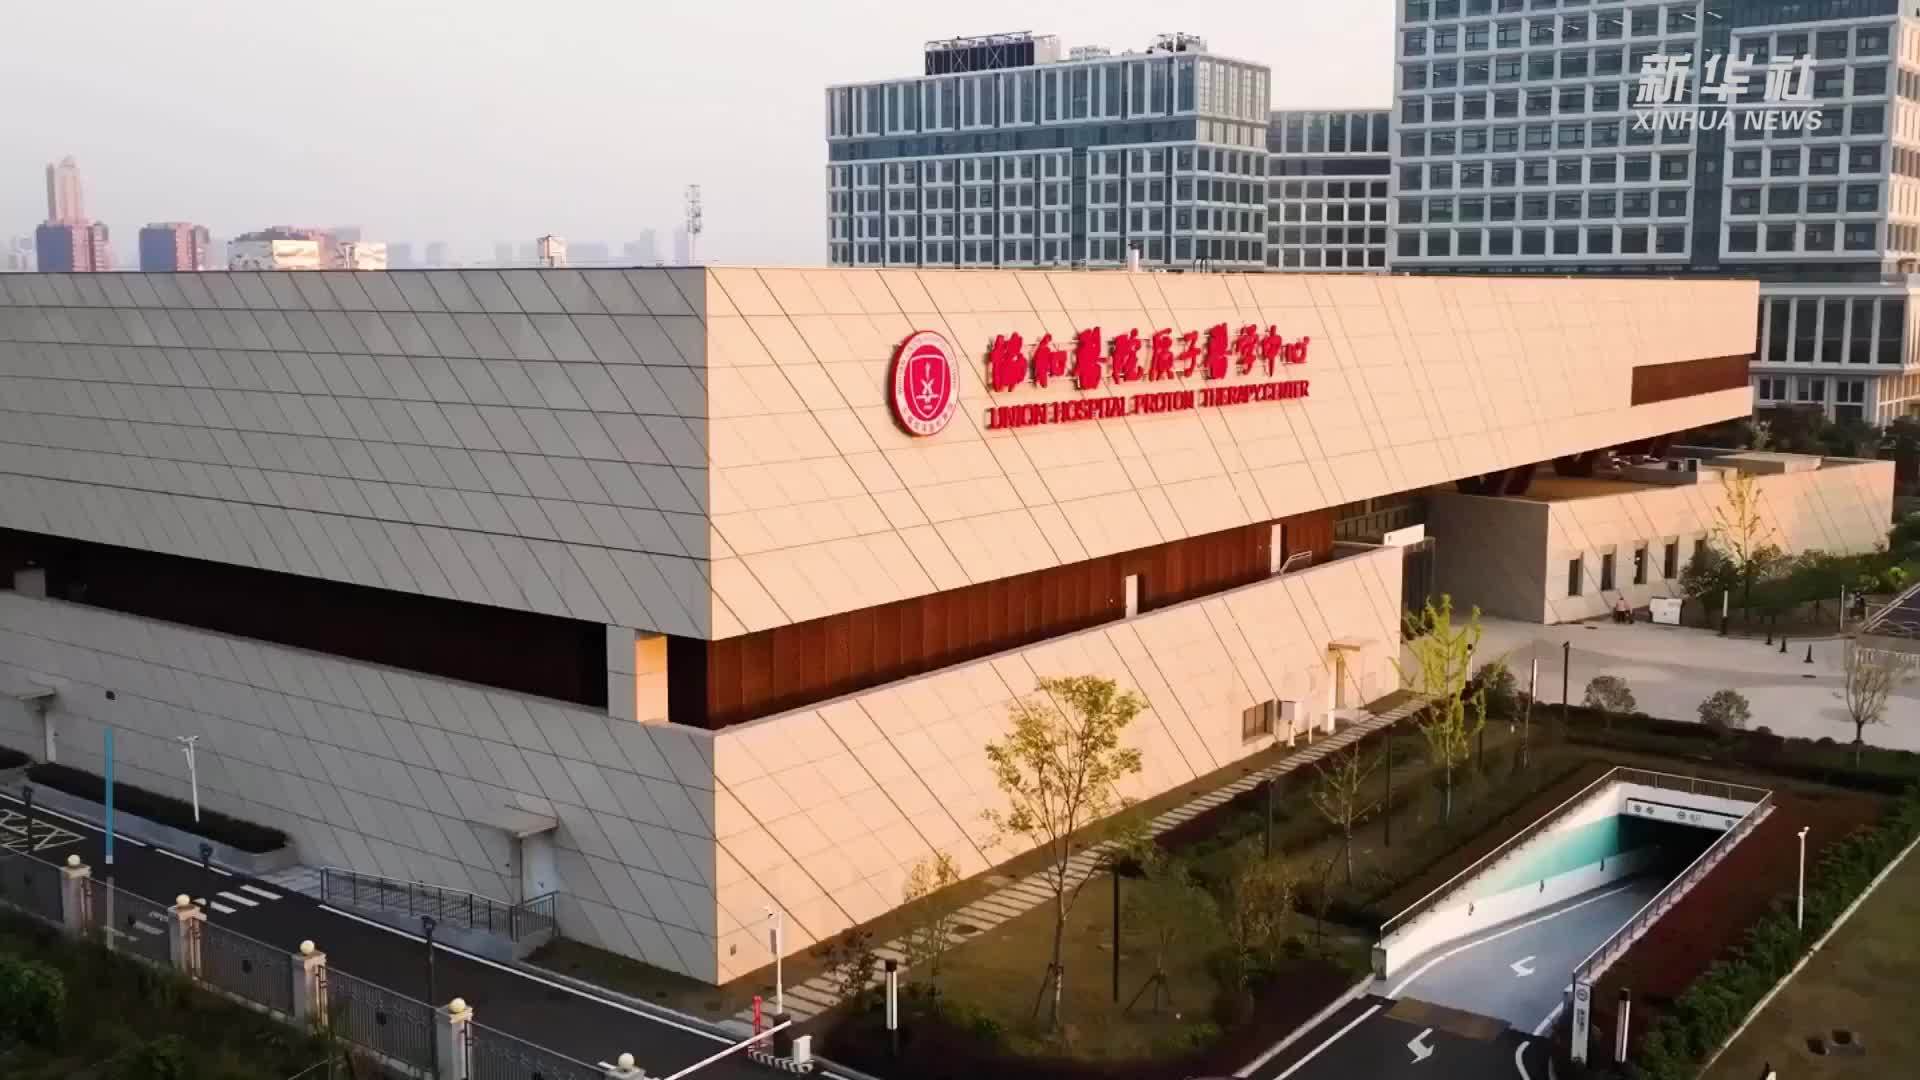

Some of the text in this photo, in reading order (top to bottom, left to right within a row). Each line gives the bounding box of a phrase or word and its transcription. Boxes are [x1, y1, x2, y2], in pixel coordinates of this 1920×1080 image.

[988, 380, 1310, 429] UNION HOSPITAL PROTON THERAPY CENTER
